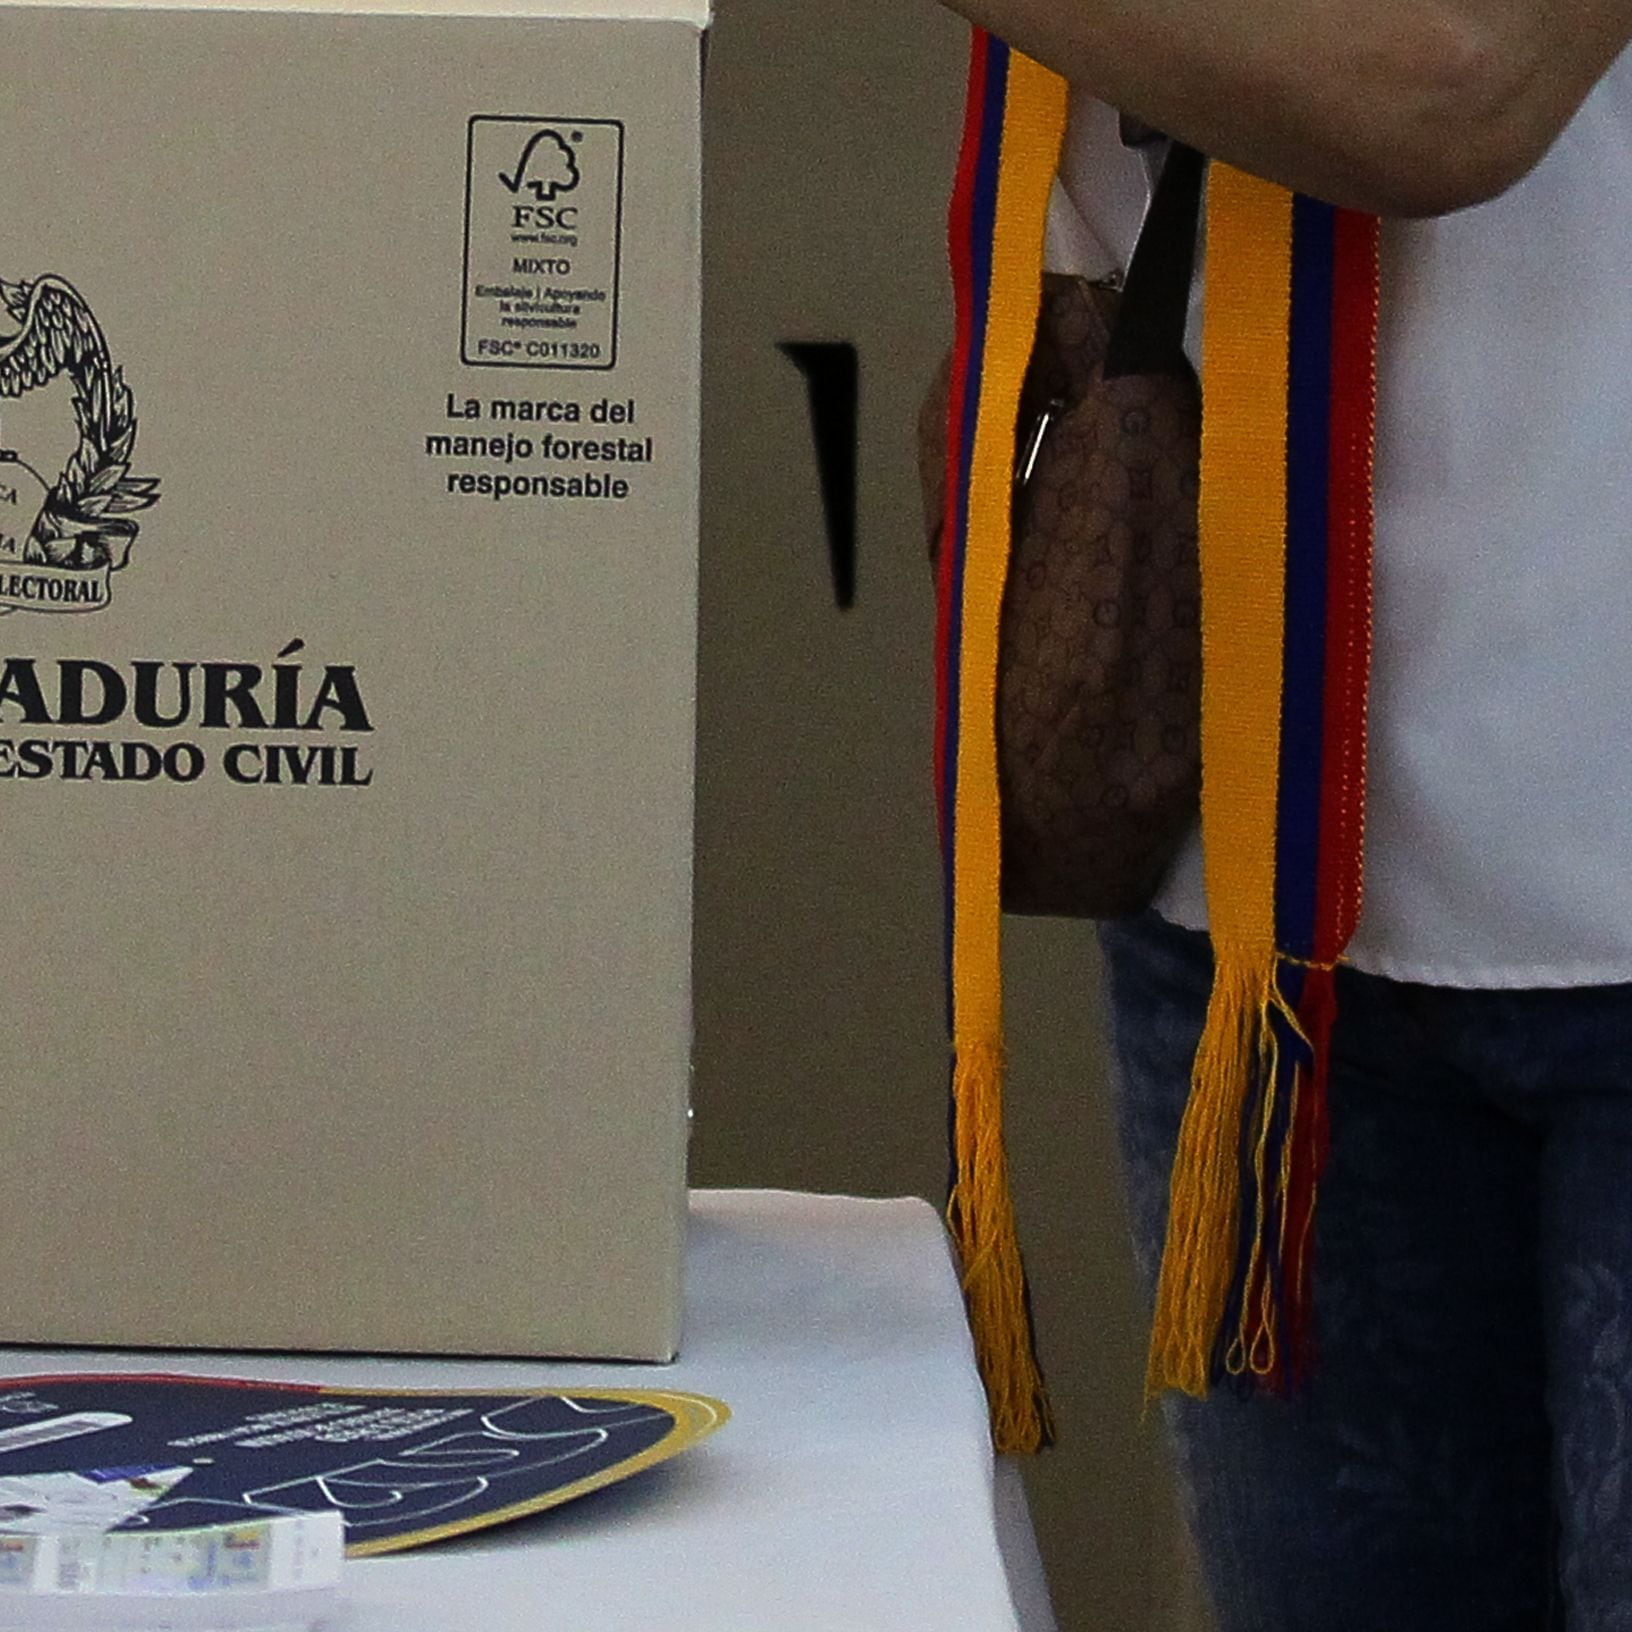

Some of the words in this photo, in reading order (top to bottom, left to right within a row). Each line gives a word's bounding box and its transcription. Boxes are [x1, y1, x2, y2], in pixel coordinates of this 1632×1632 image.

[512, 206, 578, 229] FSC
[512, 258, 571, 275] MIXTO
[526, 341, 600, 358] C011320
[446, 393, 480, 419] La
[490, 399, 580, 422] marca
[589, 397, 635, 424] del
[425, 432, 533, 463] manejo
[541, 433, 653, 462] forestal
[447, 472, 629, 500] responsable
[223, 743, 373, 786] CIVIL
